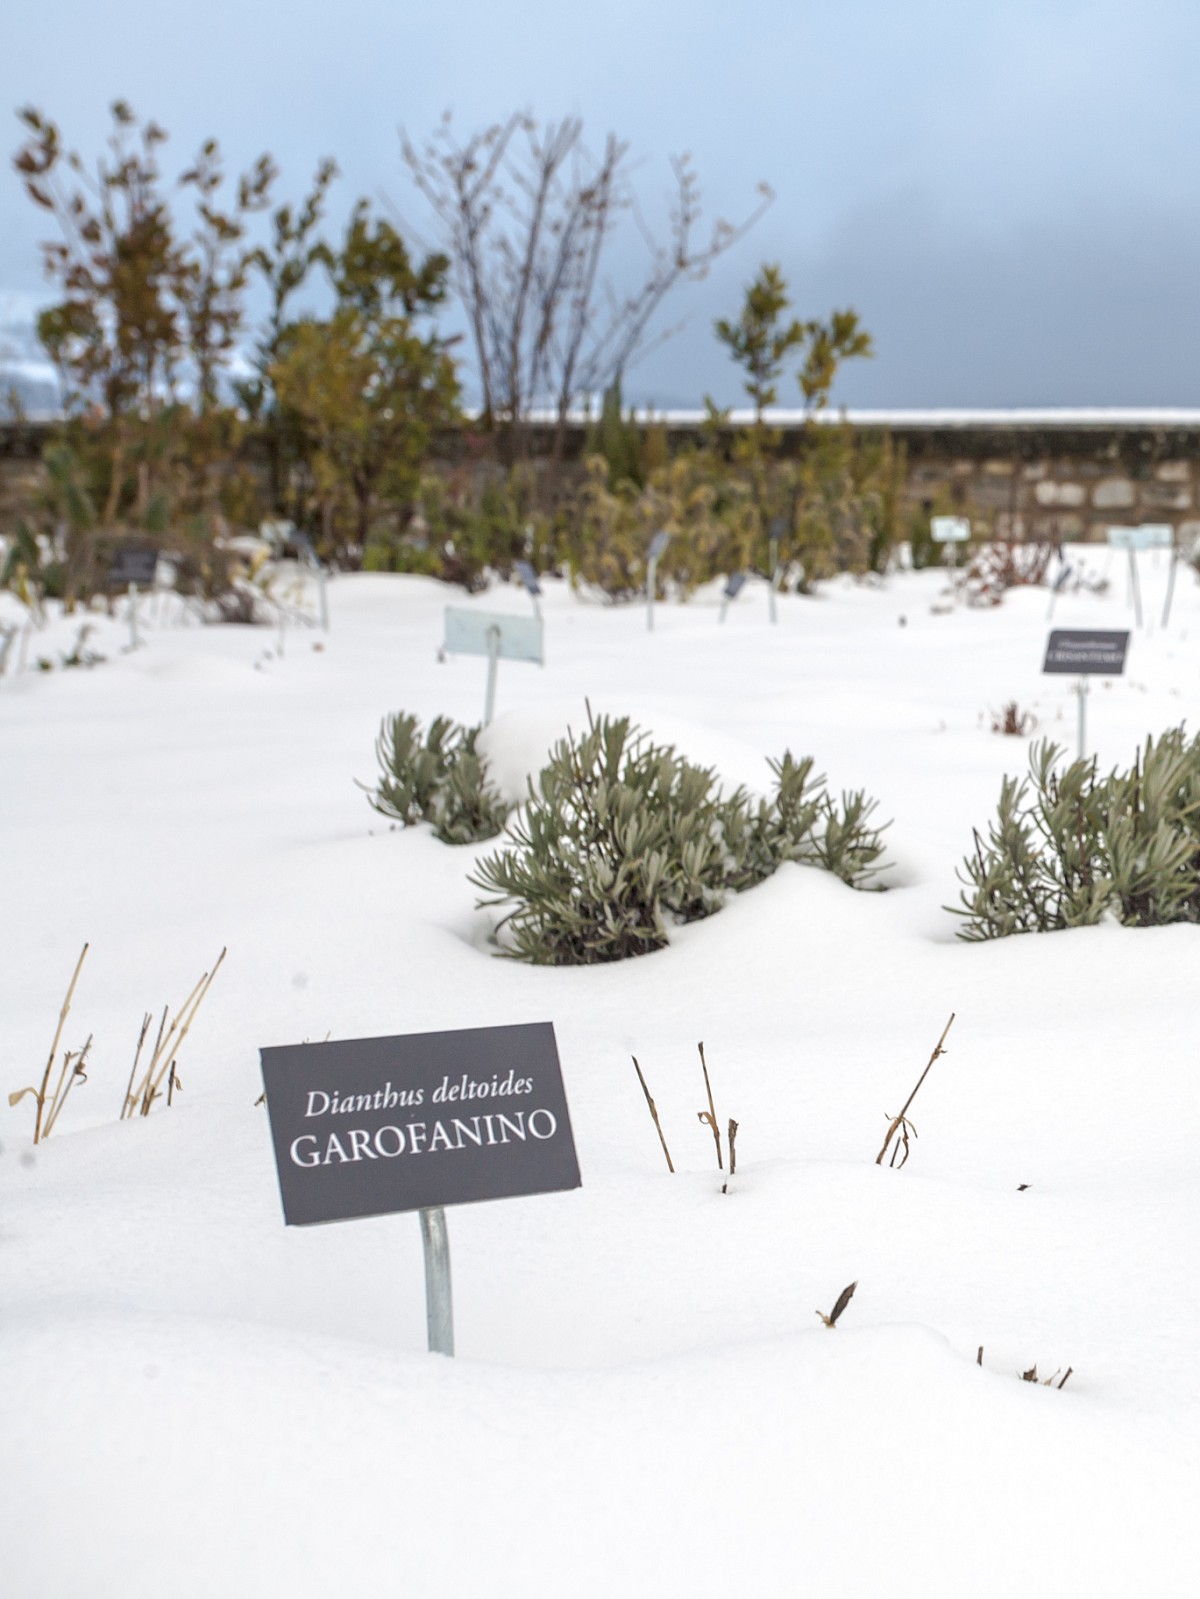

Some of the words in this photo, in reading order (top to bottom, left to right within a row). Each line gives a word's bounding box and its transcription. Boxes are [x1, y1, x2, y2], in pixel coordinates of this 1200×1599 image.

[304, 1080, 425, 1118] Dianthus
[432, 1069, 534, 1103] deltoides
[289, 1107, 558, 1168] GAROFANINO
